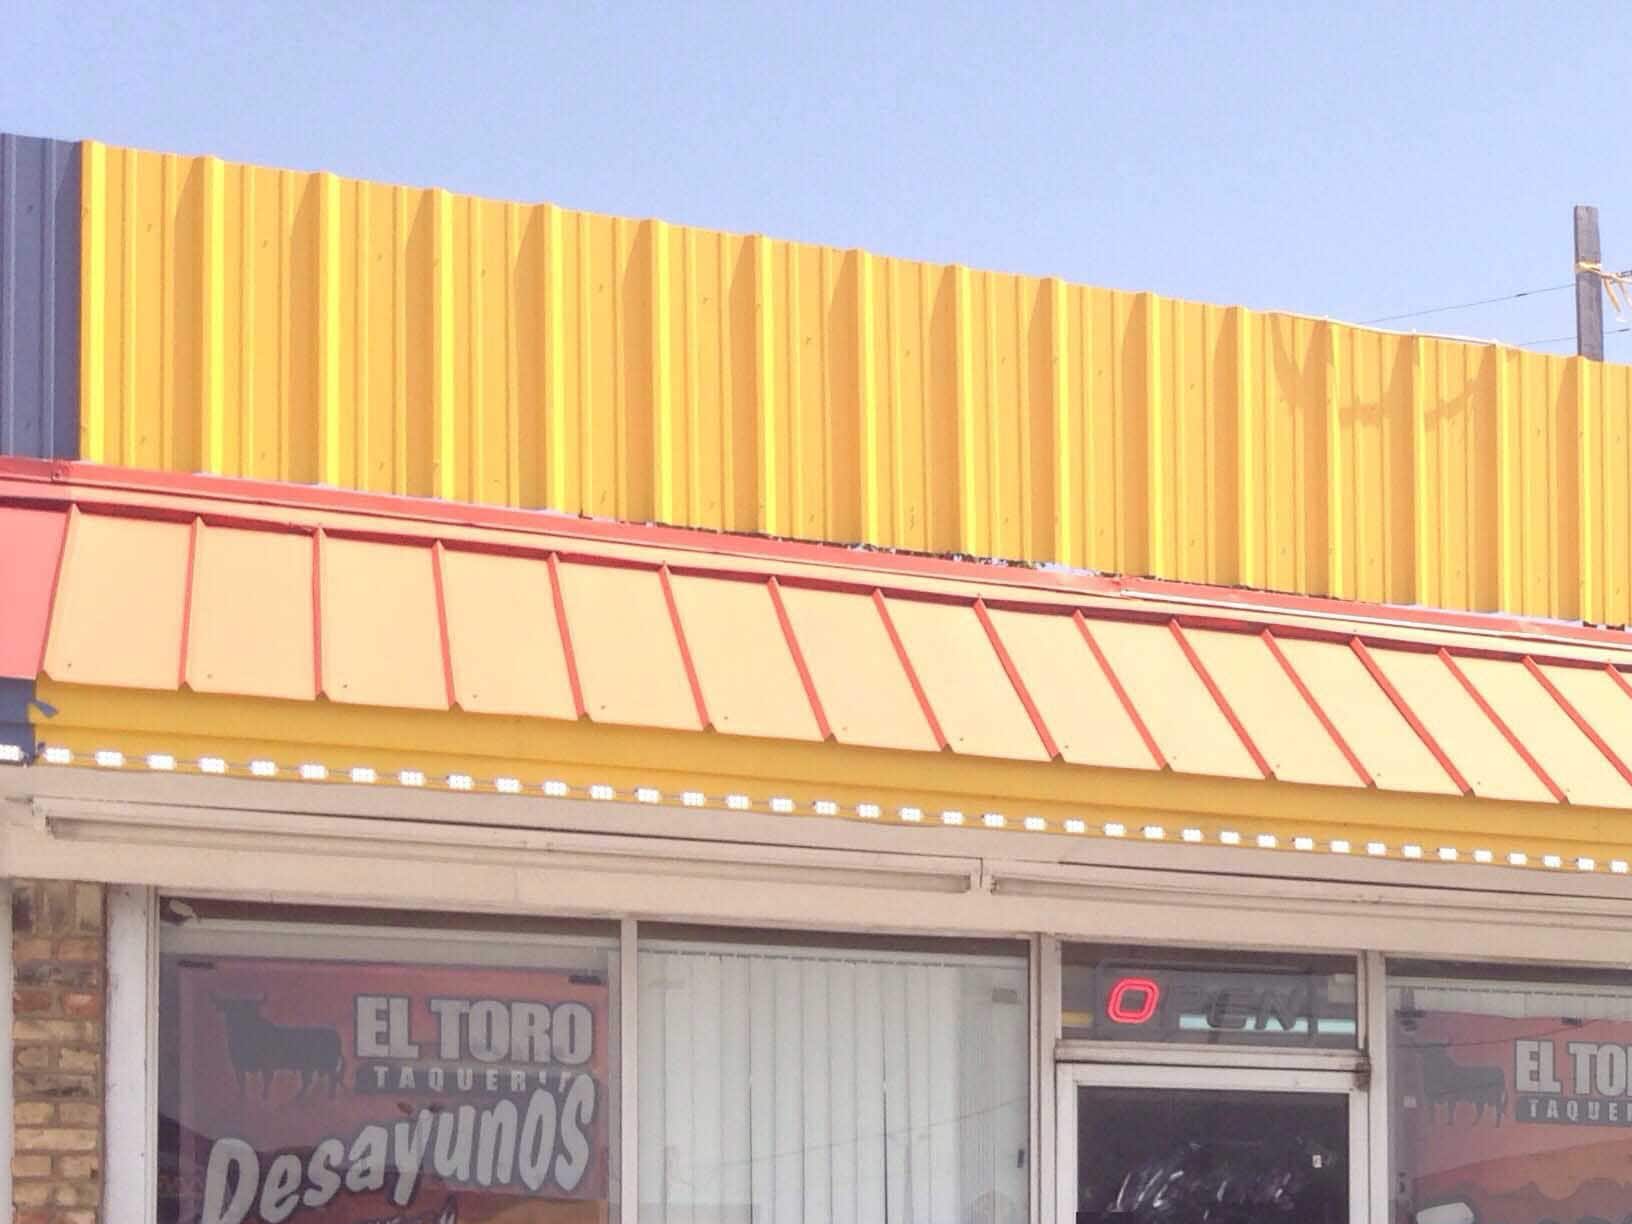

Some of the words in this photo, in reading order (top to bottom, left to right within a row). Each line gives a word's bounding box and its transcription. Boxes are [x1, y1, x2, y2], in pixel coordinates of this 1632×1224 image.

[356, 996, 420, 1060] EL
[429, 999, 594, 1065] TORO
[1514, 1039, 1562, 1094] EL
